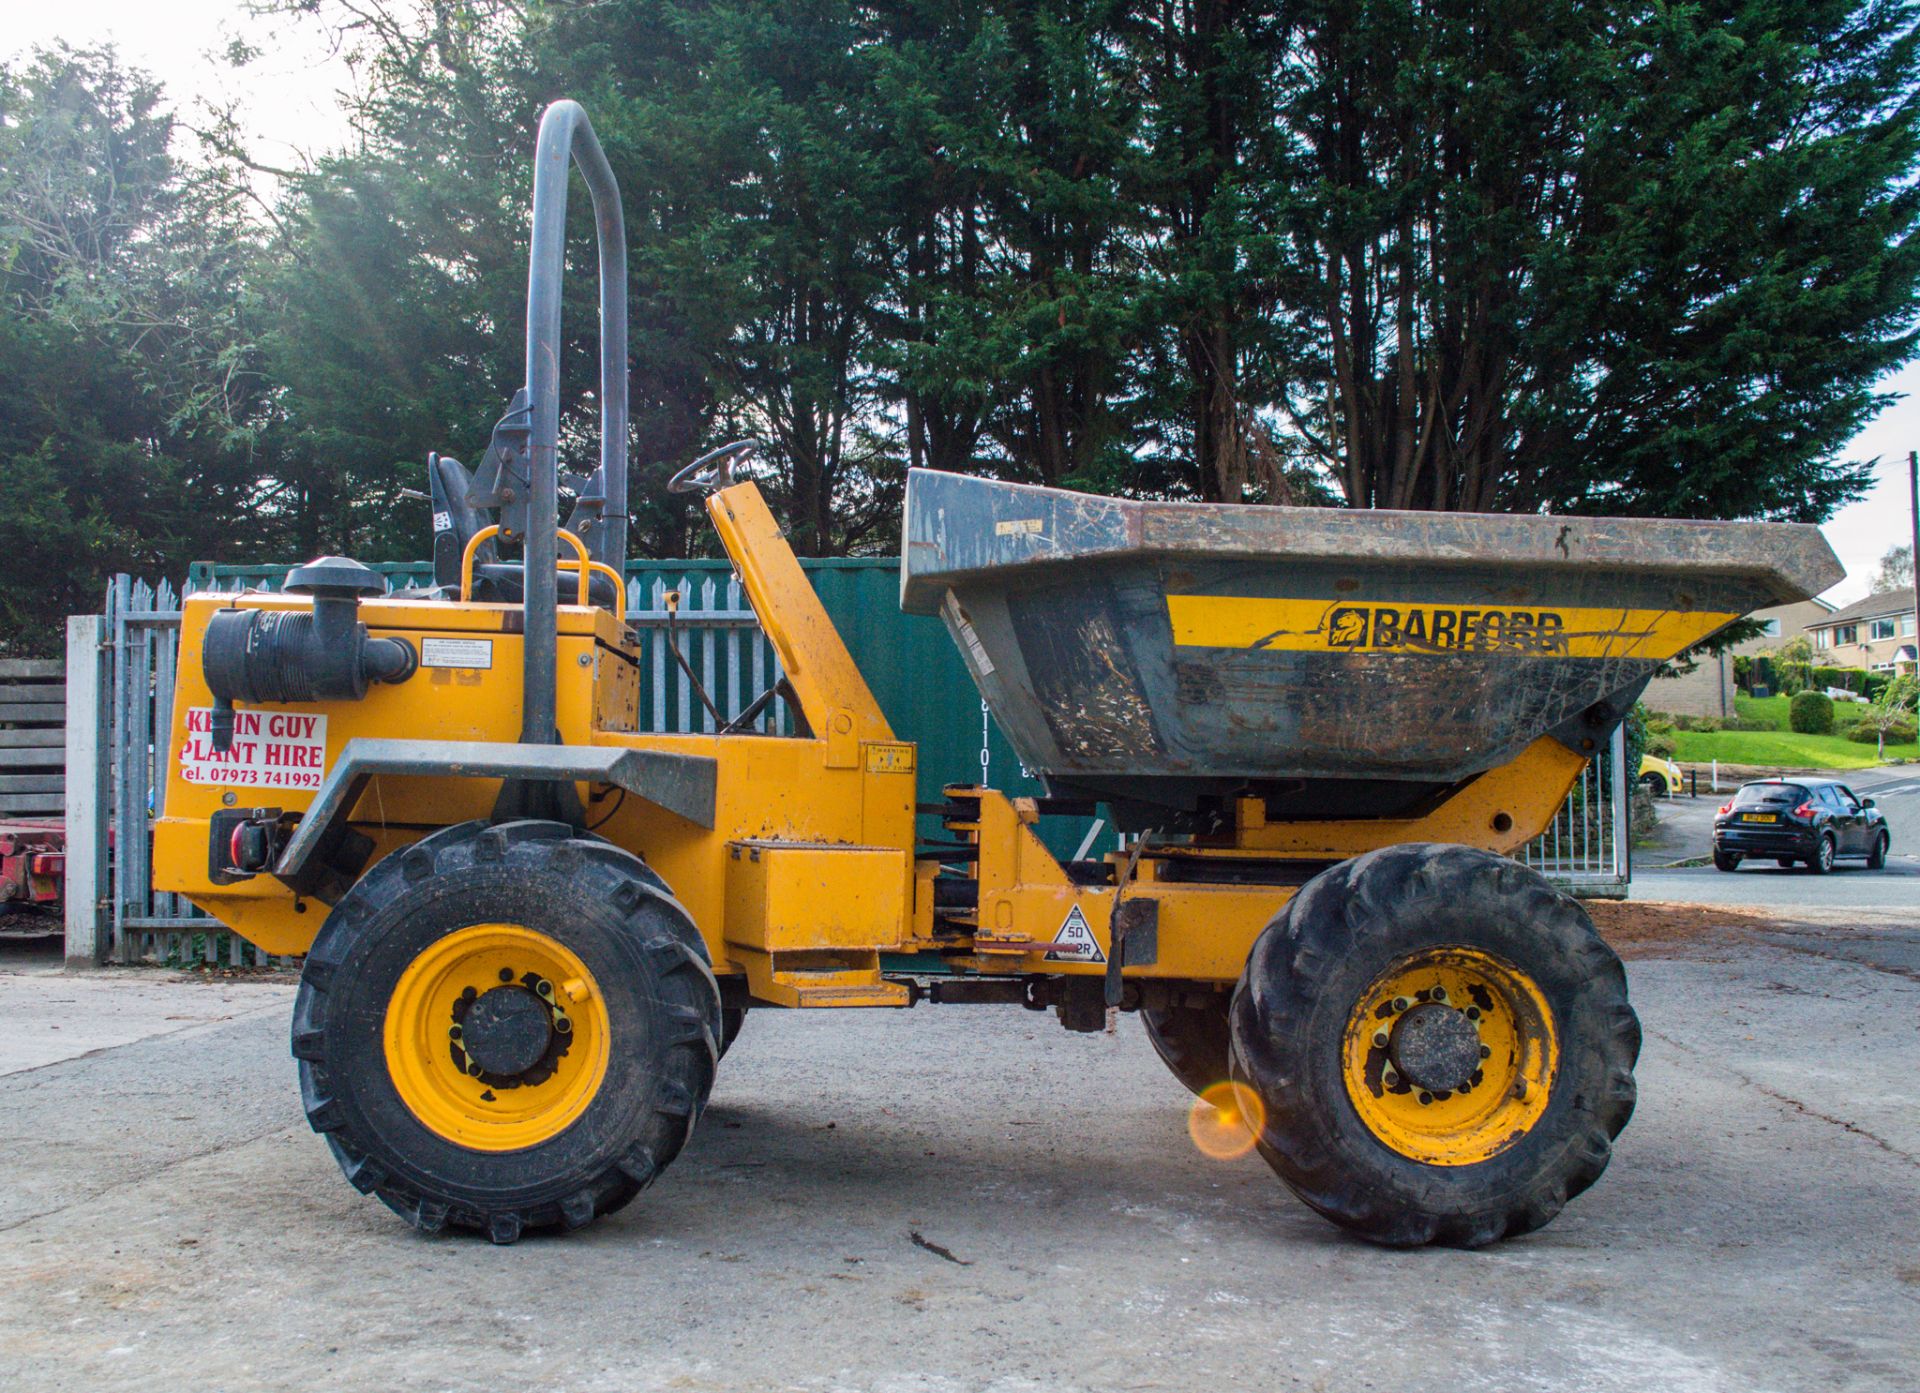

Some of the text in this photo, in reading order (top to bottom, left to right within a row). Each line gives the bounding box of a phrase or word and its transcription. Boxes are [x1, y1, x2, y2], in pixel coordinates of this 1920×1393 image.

[1372, 607, 1564, 652] BARFORD
[188, 709, 318, 739] KIN GUY
[264, 743, 323, 768] HIRE
[180, 766, 321, 787] el. 07973 741992
